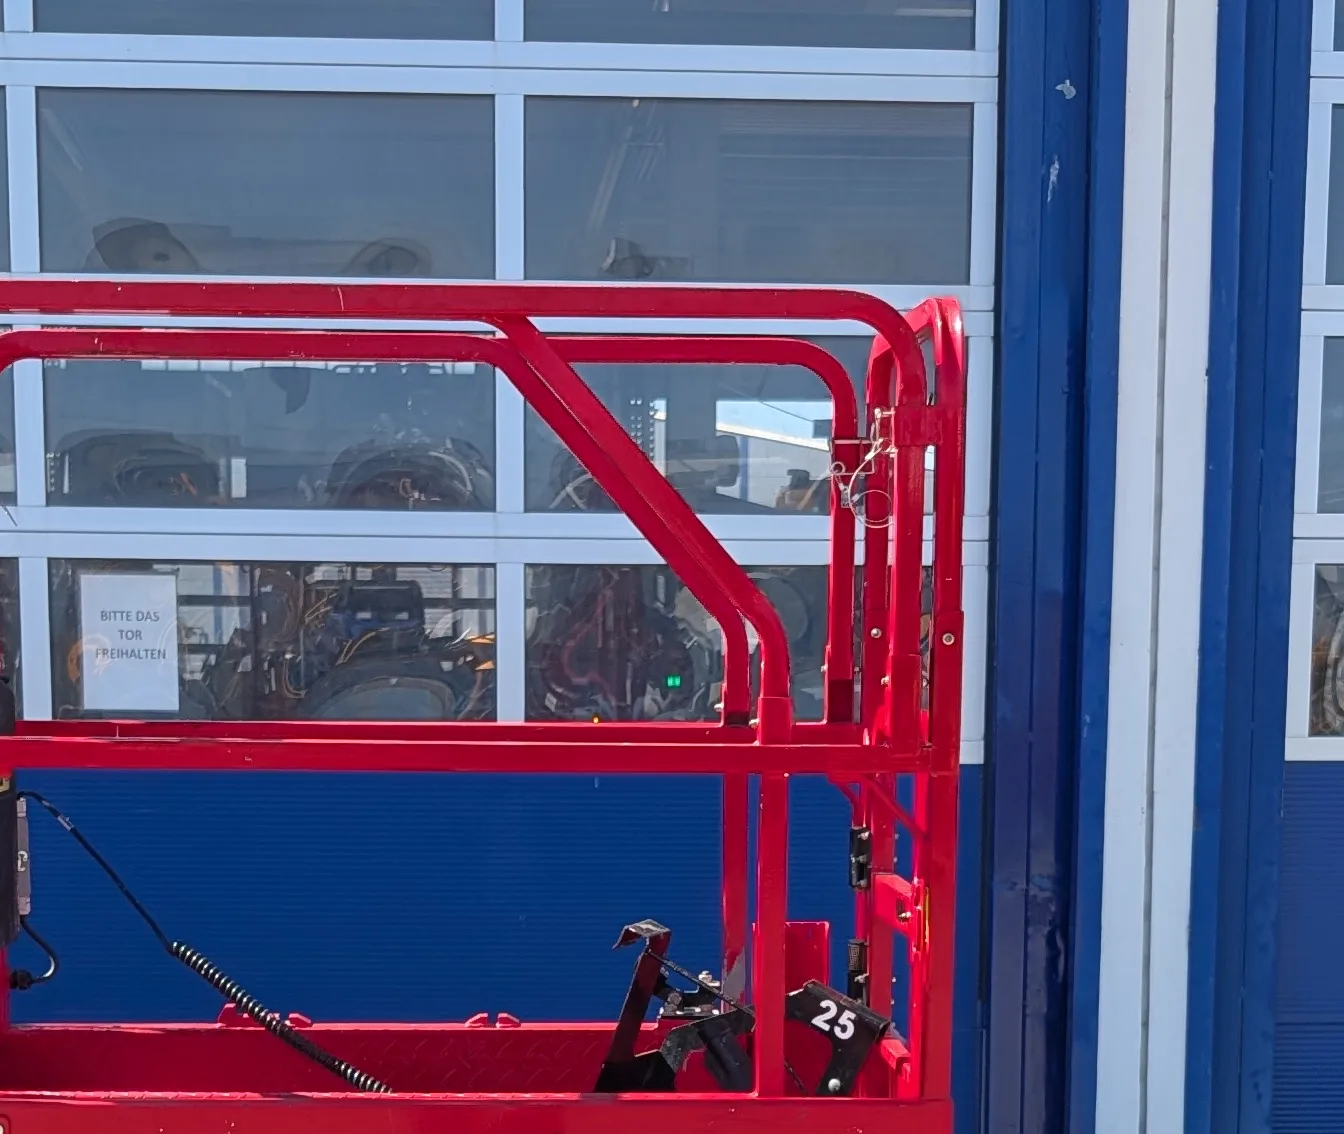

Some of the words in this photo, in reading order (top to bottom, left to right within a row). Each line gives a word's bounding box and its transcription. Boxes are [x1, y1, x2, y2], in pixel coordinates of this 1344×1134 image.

[100, 610, 132, 622] BITTE
[136, 610, 160, 622] DAS
[118, 629, 143, 641] TOR
[95, 648, 166, 660] FREIHALTEN
[811, 999, 857, 1040] 25
